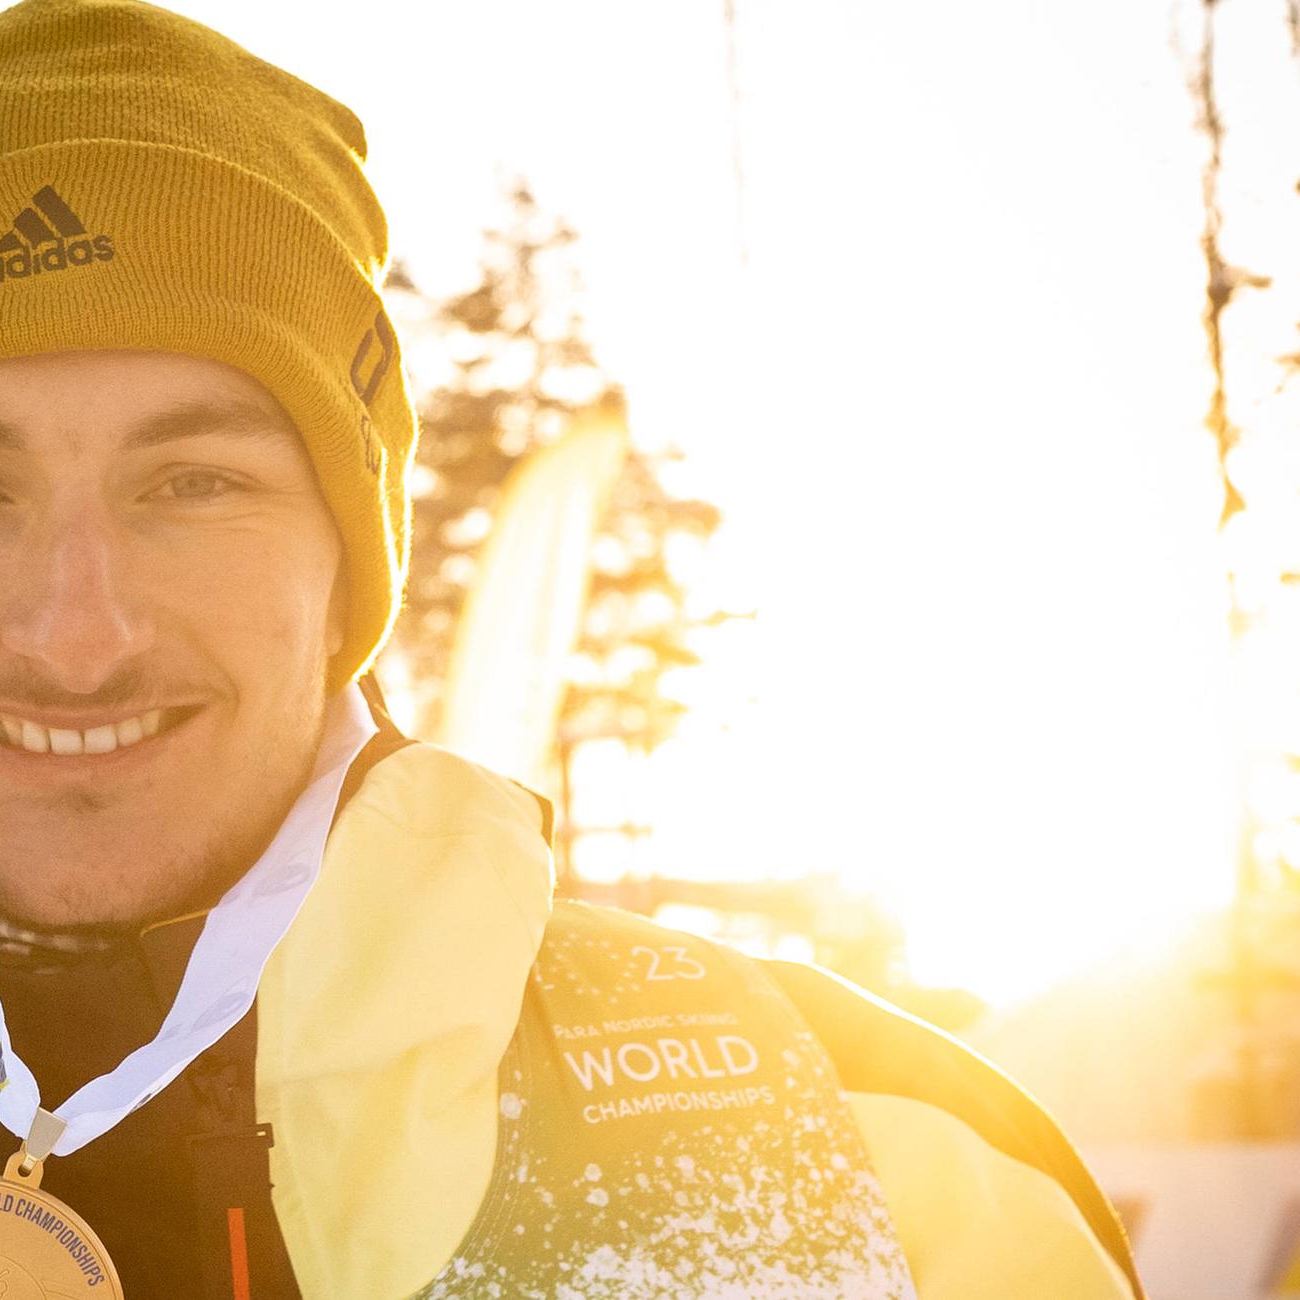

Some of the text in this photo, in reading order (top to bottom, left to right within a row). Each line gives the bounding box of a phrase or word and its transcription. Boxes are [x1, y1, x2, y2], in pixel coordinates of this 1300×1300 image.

[631, 946, 706, 980] 23
[553, 1012, 740, 1040] PARA NORDIC SKIING
[564, 1035, 759, 1092] WORLD
[583, 1086, 776, 1124] CHAMPIONSHIPS
[15, 1198, 105, 1287] CHAMPIONSHIPS
